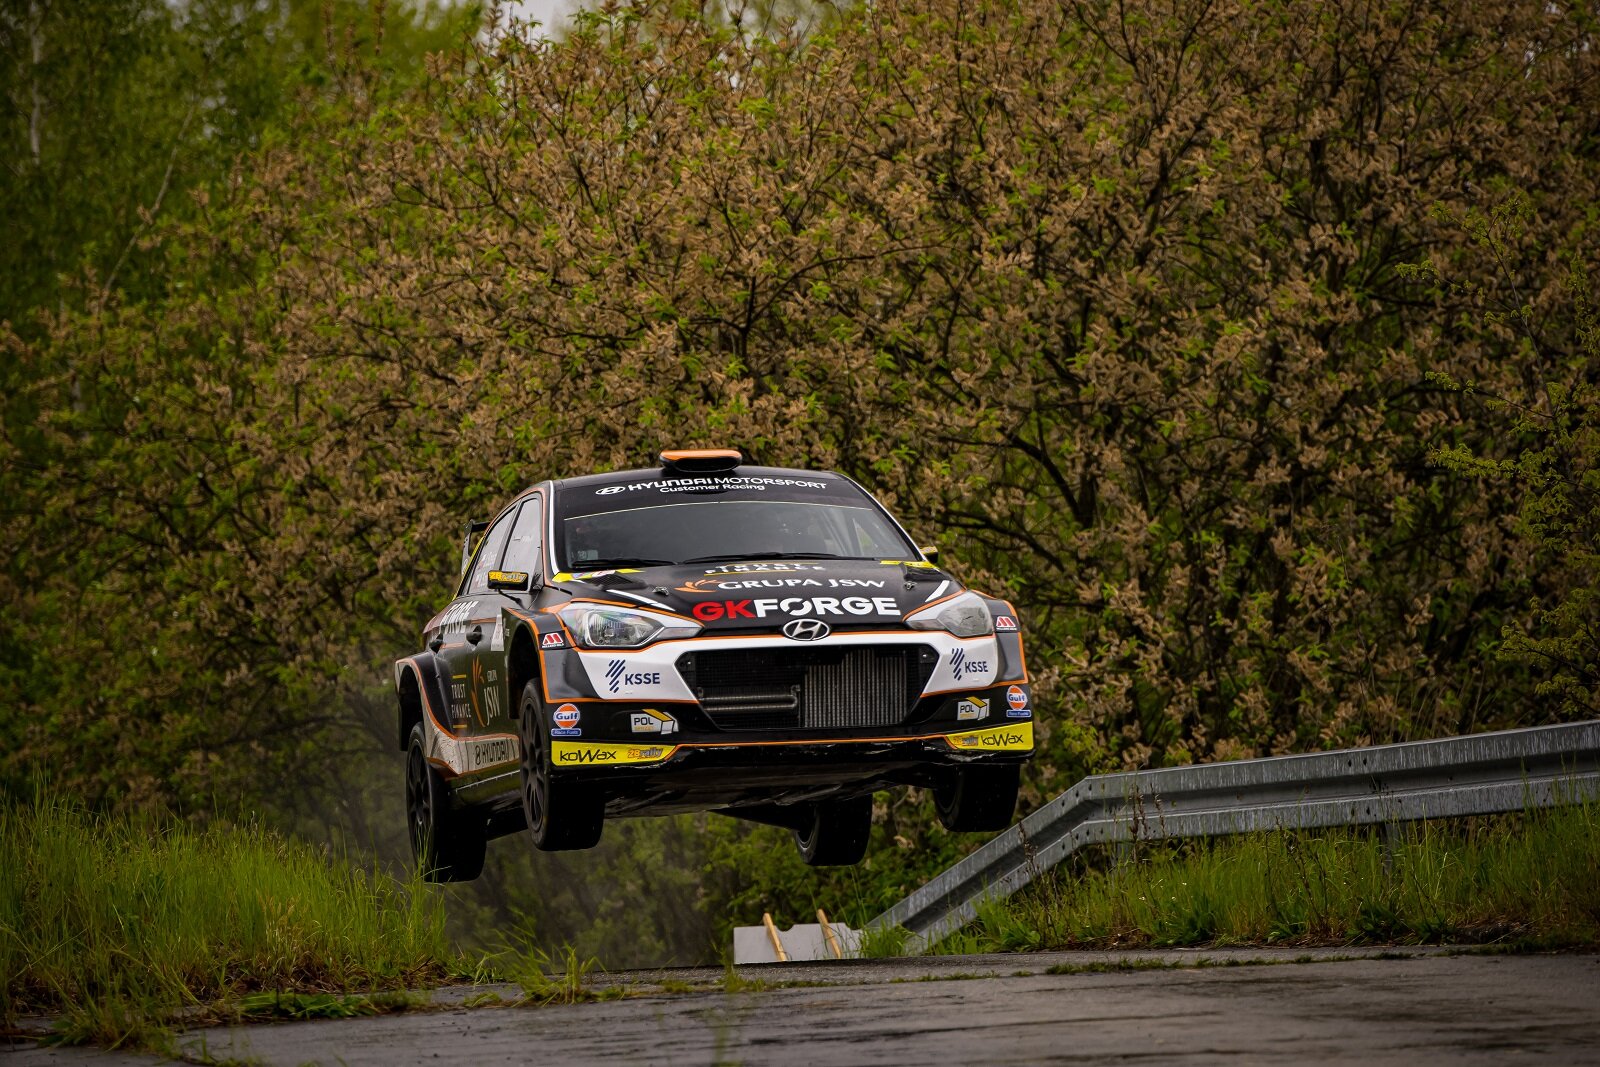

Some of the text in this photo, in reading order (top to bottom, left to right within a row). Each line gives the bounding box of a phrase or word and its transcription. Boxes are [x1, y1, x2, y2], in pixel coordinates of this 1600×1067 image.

[628, 478, 828, 492] HYUNDAI MOTORSPORT
[659, 484, 766, 493] Customer Racing
[718, 578, 885, 590] GRUPA JSW
[965, 661, 988, 674] KSSE
[624, 672, 660, 686] KSSE
[451, 684, 466, 699] TRUST
[1008, 694, 1026, 702] Gulf
[451, 703, 472, 719] FINANCE
[484, 685, 500, 726] JSW
[960, 704, 974, 714] POL
[555, 712, 578, 720] Gulf
[634, 717, 654, 726] POL
